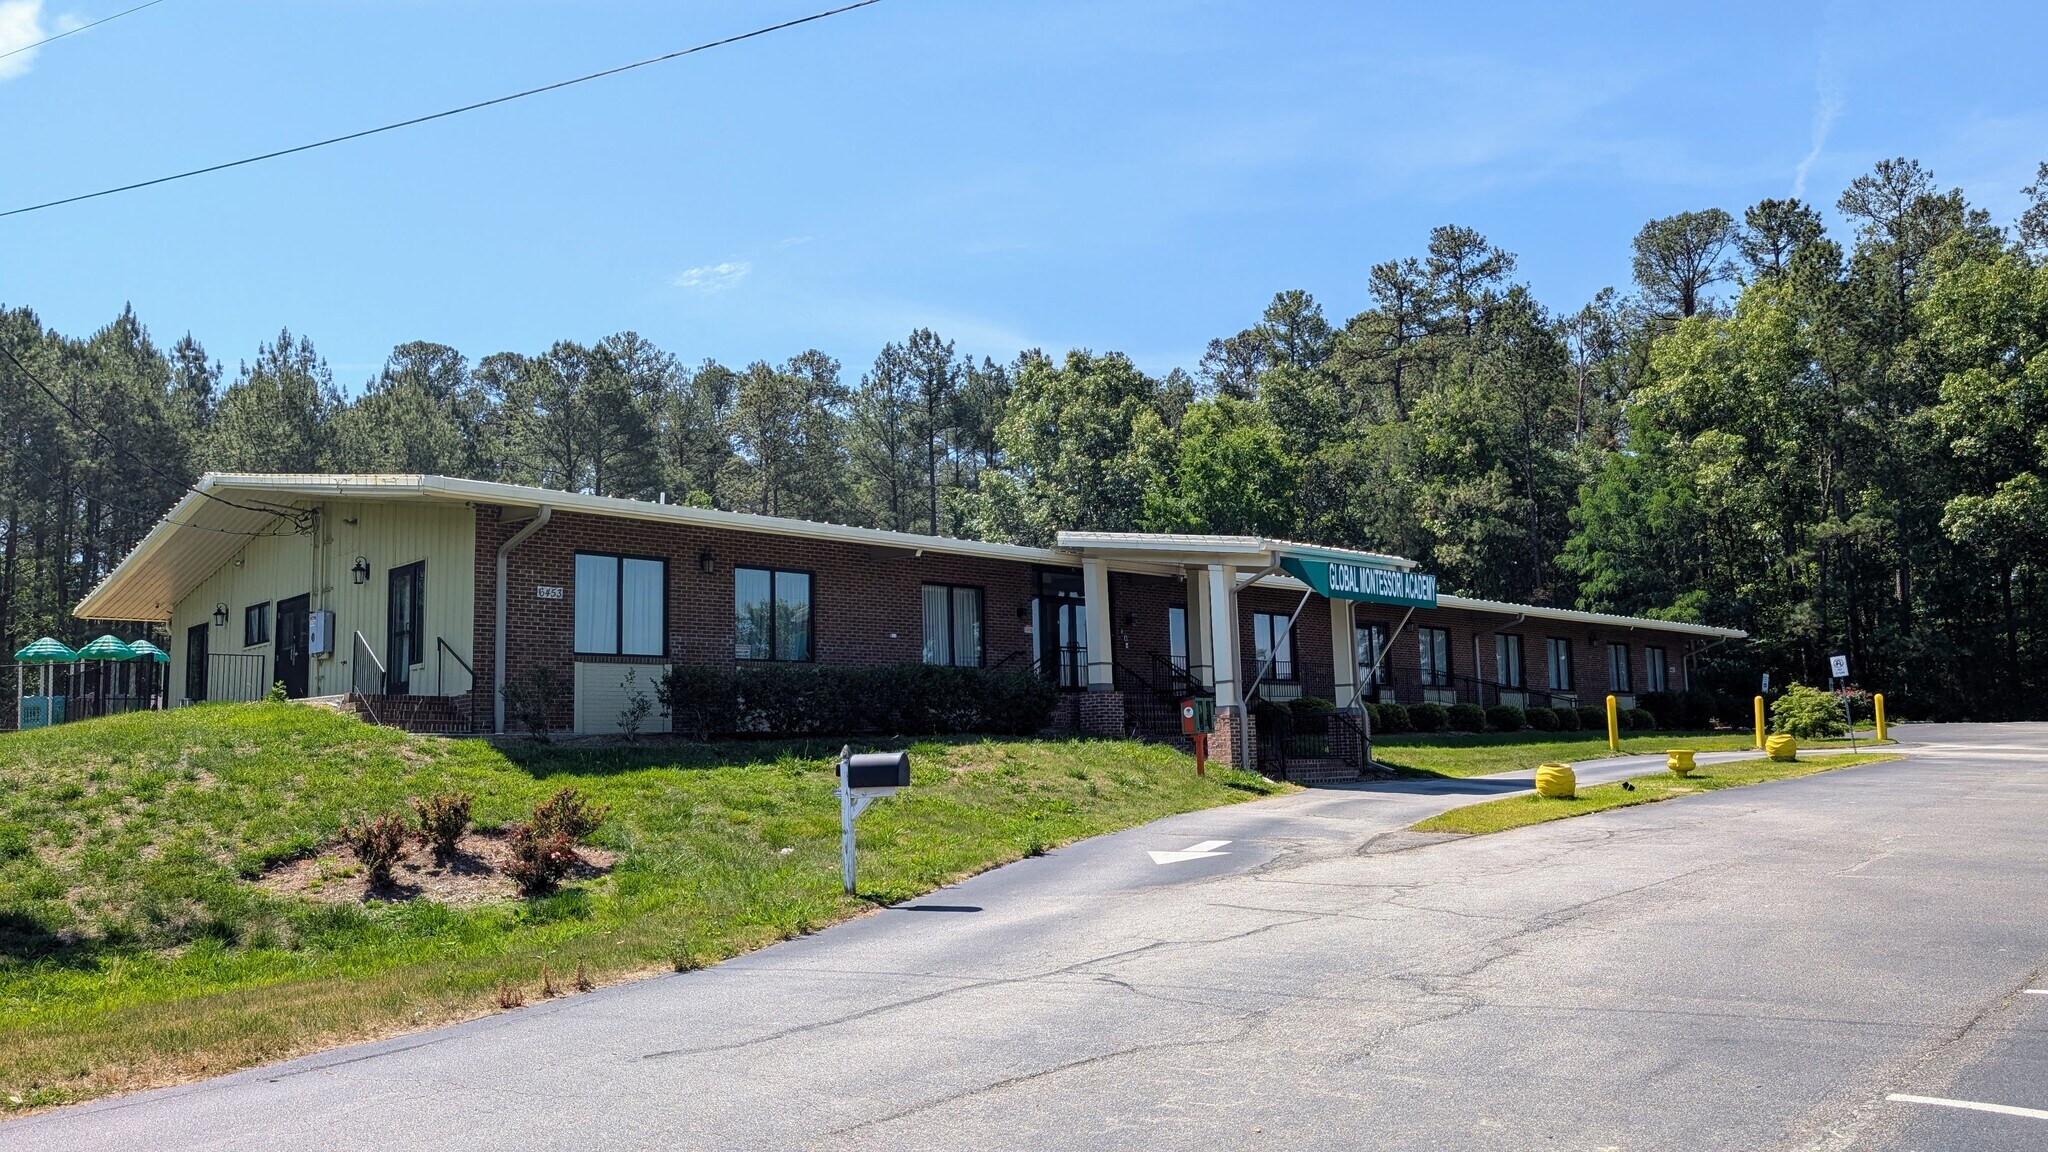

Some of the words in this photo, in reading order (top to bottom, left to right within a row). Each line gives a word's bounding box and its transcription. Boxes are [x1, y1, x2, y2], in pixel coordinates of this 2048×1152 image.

[539, 587, 562, 598] 6453
[1329, 563, 1359, 592] GLOBAL
[1360, 567, 1404, 597] MONTESSORI
[1405, 573, 1436, 601] ACADEMY
